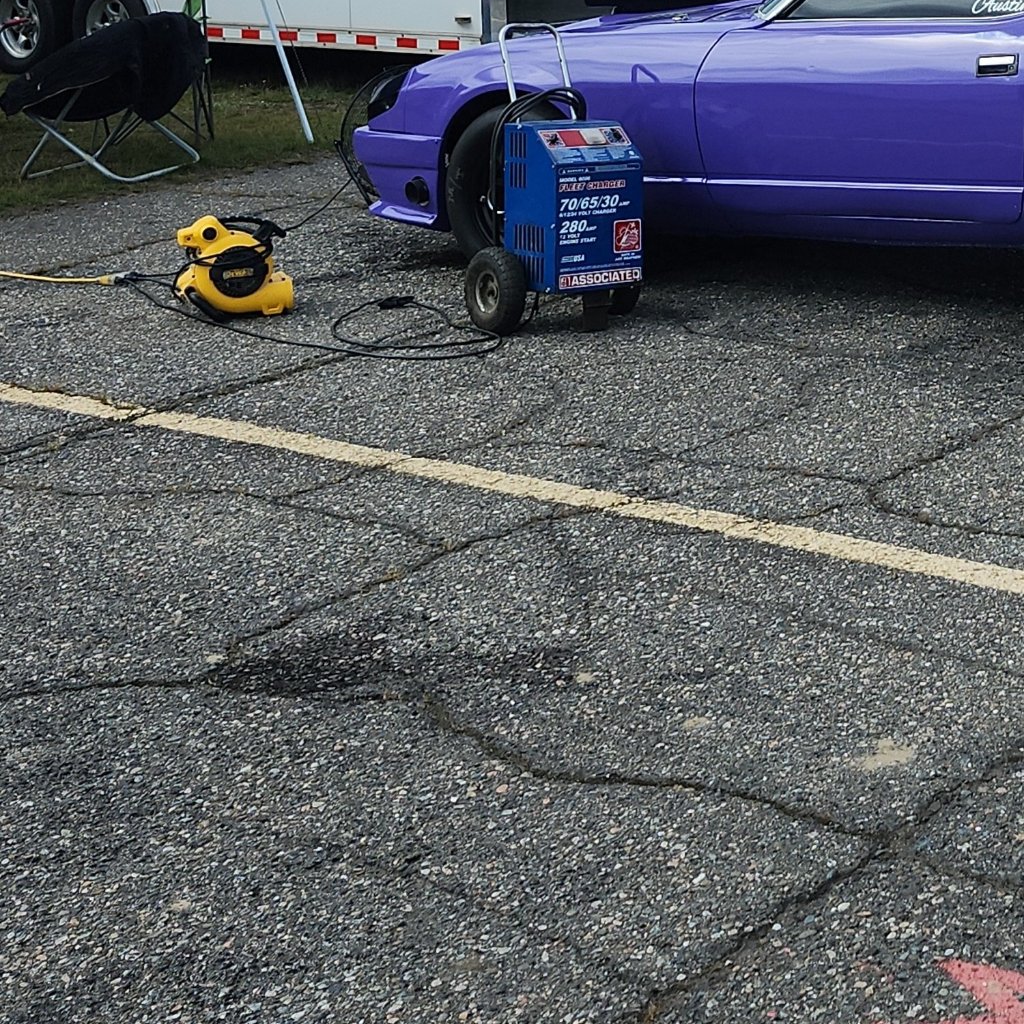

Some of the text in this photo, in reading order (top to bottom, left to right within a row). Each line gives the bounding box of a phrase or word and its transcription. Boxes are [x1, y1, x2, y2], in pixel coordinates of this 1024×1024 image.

[559, 180, 625, 192] FLEET CHARGER
[560, 194, 620, 211] 70/65/30
[559, 220, 587, 233] 280
[571, 269, 641, 286] ASSOCIATED
